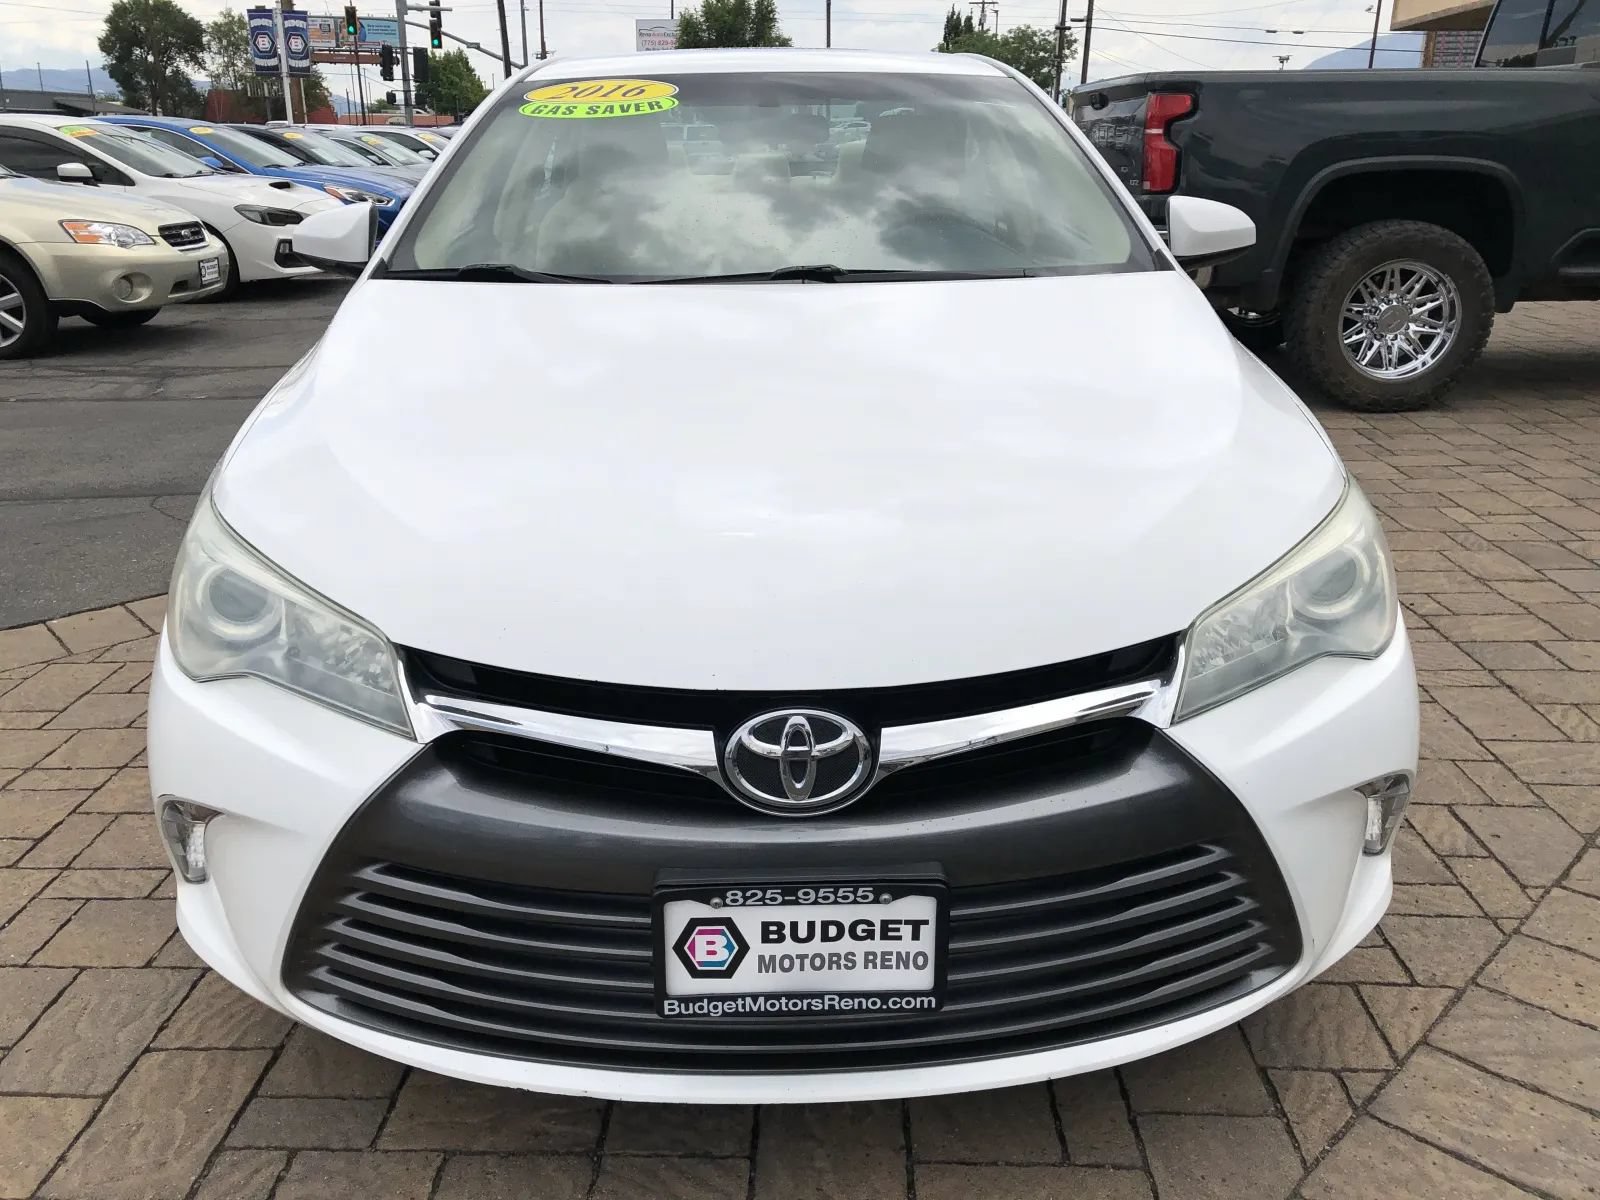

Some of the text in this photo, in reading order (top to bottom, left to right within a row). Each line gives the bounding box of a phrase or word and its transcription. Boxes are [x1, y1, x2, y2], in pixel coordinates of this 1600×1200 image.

[546, 84, 653, 99] 2016
[530, 100, 664, 116] GAS SAVER
[725, 887, 875, 906] 825-9555
[760, 919, 930, 944] BUDGET
[694, 934, 730, 962] B
[757, 950, 929, 974] MOTORS RENO
[663, 994, 936, 1017] BudgetMotorsReno.com
